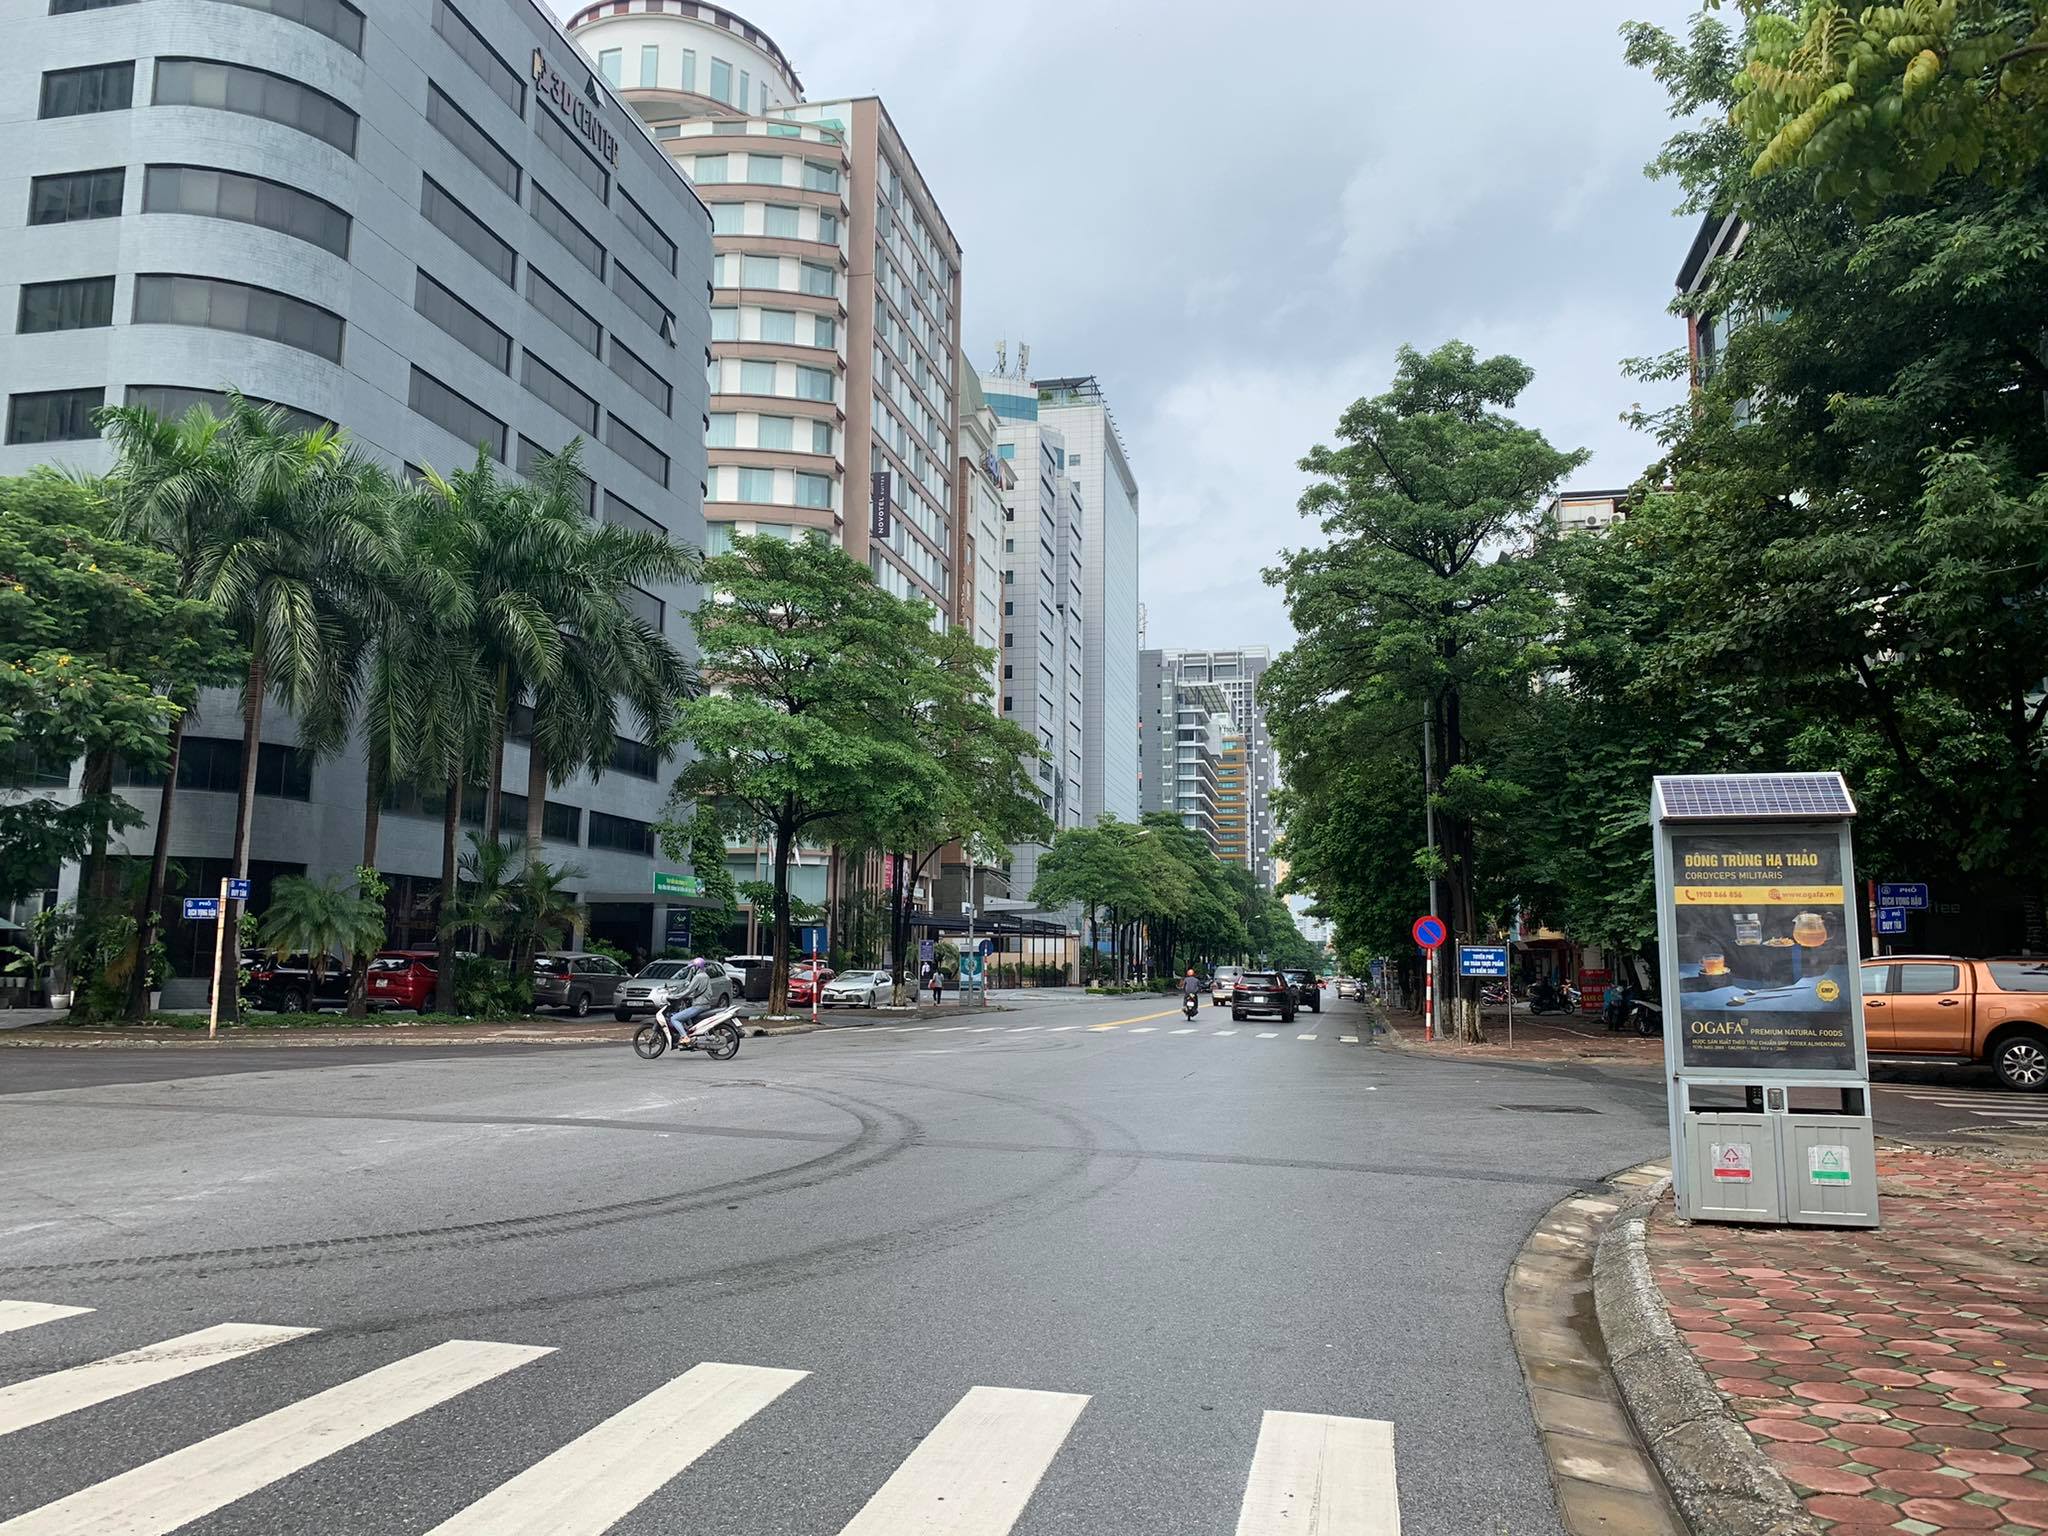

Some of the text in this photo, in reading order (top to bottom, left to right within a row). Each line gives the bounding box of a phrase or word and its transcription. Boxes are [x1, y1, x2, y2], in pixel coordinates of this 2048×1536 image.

[1684, 849, 1818, 869] ĐÔNG TRÙNG HẠ THẢO
[1685, 871, 1783, 880] CORDYCEPS MILITARIS
[1782, 890, 1835, 899] www.ogafa.vn
[1691, 1021, 1744, 1035] OGAFA
[1750, 1028, 1783, 1036] PREMIUM
[1784, 1029, 1817, 1037] NATURAL
